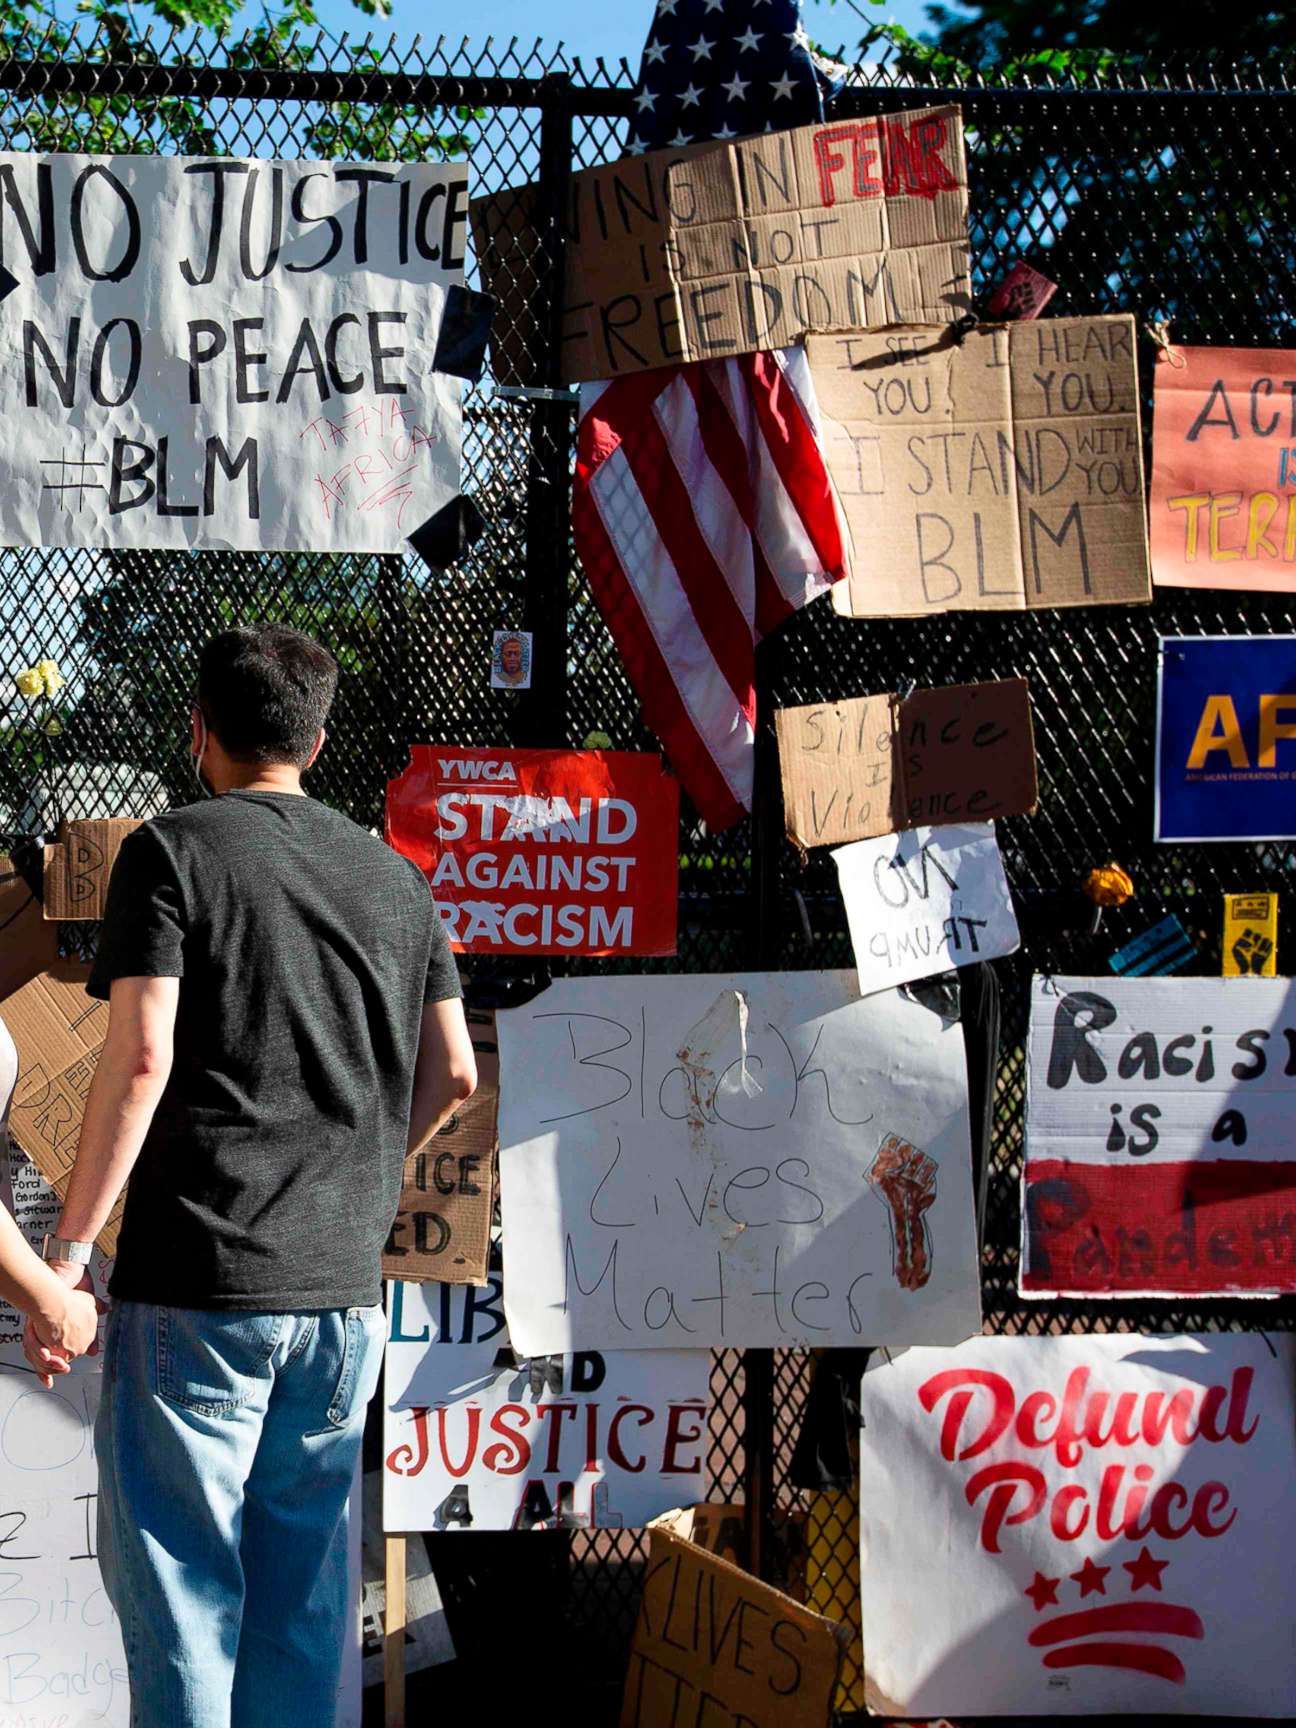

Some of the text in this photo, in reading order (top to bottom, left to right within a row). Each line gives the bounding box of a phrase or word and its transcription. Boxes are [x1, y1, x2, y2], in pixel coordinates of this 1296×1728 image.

[736, 139, 792, 218] IN
[814, 115, 957, 207] FEAR
[179, 161, 468, 286] JUSTICE
[640, 219, 839, 281] IS NOT
[23, 310, 408, 408] NO PEACE
[836, 339, 873, 370] I
[985, 326, 1133, 367] I HEAR
[40, 435, 260, 519] #BLM
[314, 424, 437, 519] AFRICA
[834, 429, 1071, 497] I STAND
[1075, 461, 1139, 496] YOU
[1077, 429, 1137, 455] WITH
[916, 503, 1091, 603] BLM
[802, 703, 1008, 753] Silence
[438, 759, 516, 781] YWCA
[434, 793, 637, 844] STAND
[431, 852, 636, 892] AGAINST
[434, 901, 634, 947] RACISM
[533, 1007, 874, 1130] Black
[1106, 1103, 1162, 1156] is
[1211, 1109, 1247, 1146] a
[591, 1136, 824, 1227] Lives
[563, 1234, 874, 1336] Matter
[385, 1397, 706, 1477] JUSTICE
[917, 1365, 1260, 1469] Defund
[965, 1461, 1238, 1554] Police
[662, 1554, 807, 1696] LIVES
